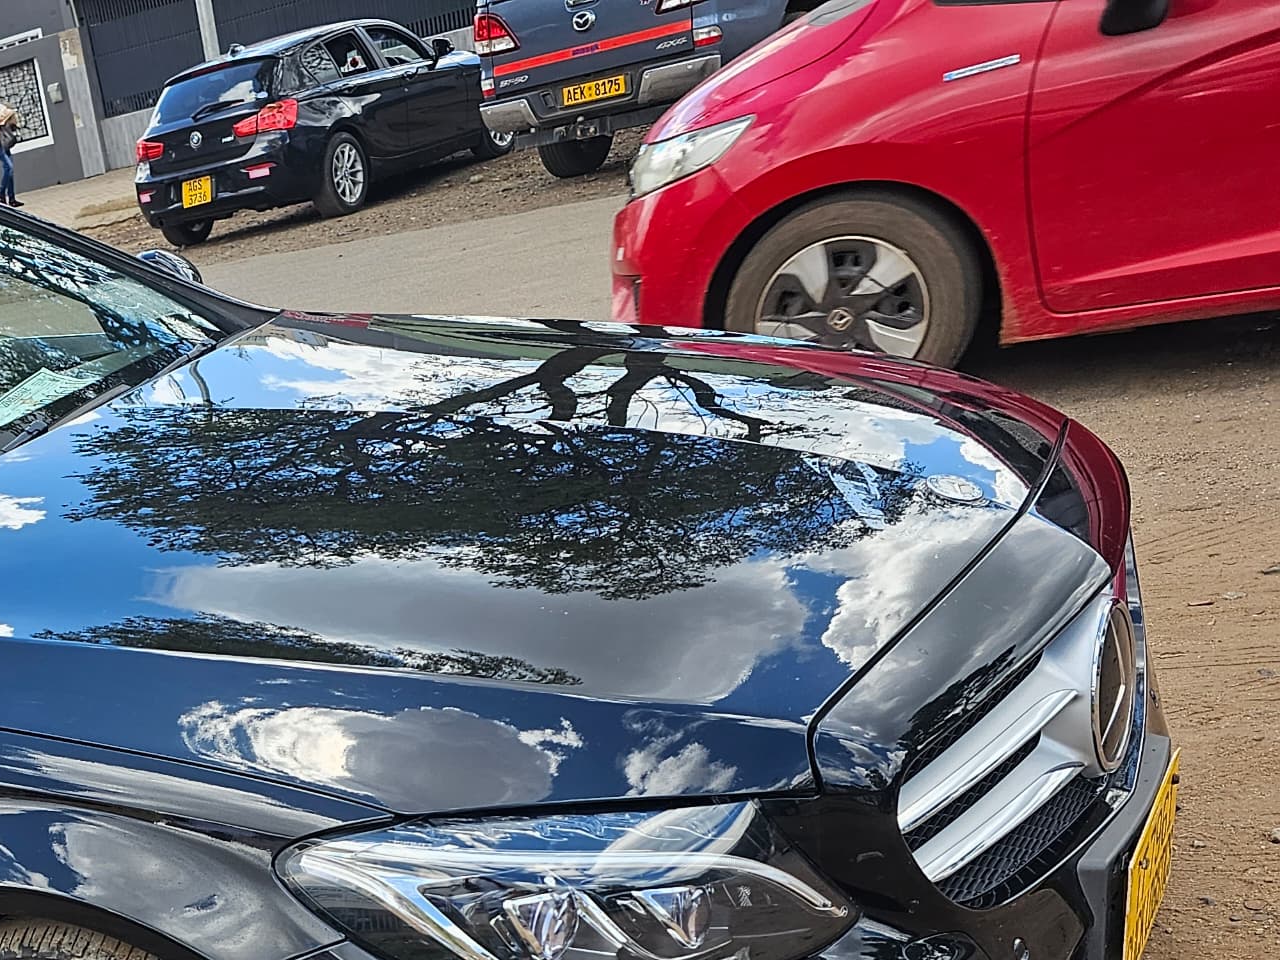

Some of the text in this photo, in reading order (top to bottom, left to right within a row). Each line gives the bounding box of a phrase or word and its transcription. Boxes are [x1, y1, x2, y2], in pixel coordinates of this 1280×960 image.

[566, 78, 621, 103] AEK 8175
[188, 179, 202, 192] AGS
